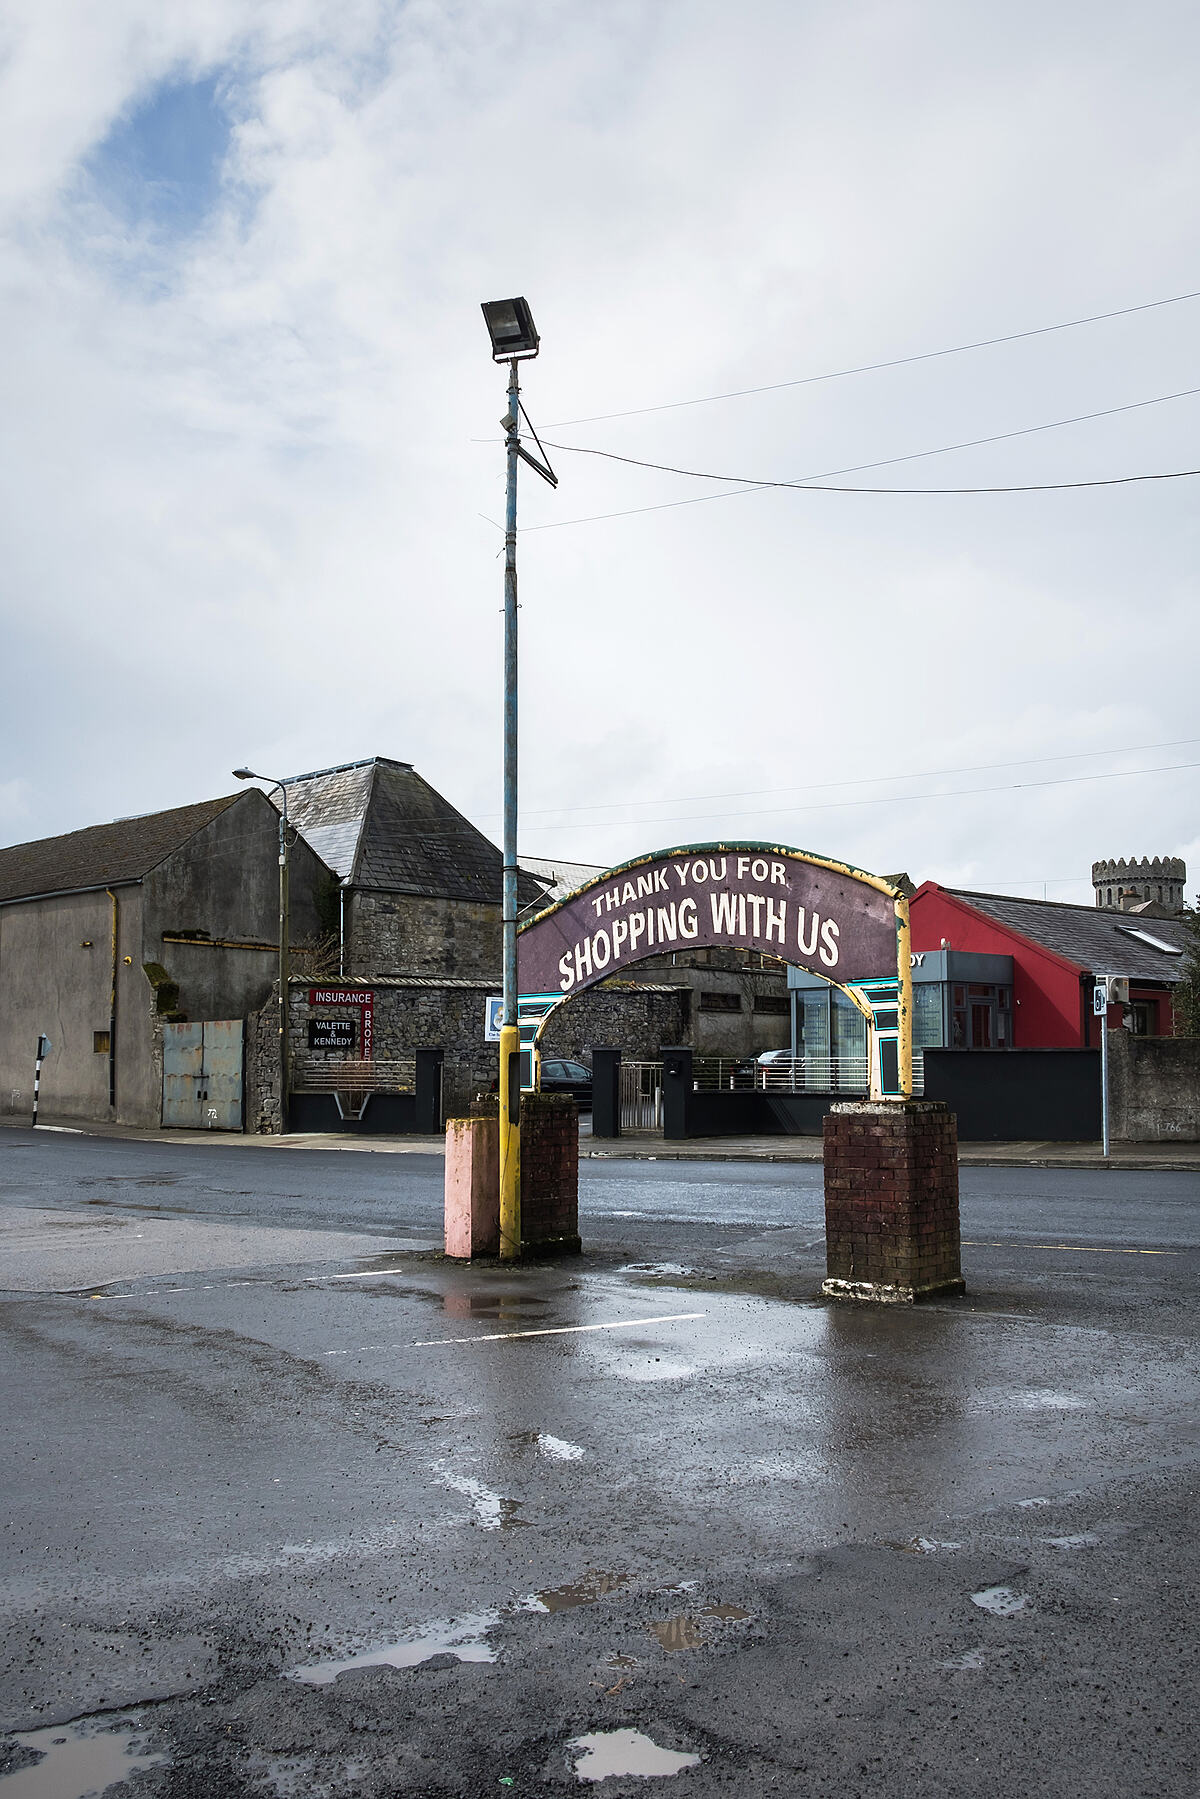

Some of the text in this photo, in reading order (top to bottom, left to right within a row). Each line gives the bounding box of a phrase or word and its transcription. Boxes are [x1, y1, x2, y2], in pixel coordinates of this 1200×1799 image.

[591, 857, 786, 917] THANK YOU FOR
[559, 892, 840, 992] SHOPPING WITH US
[315, 991, 371, 1004] INSURANCE
[315, 1021, 351, 1030] VALETTE
[330, 1030, 336, 1038] &
[314, 1037, 352, 1046] KENNEDY
